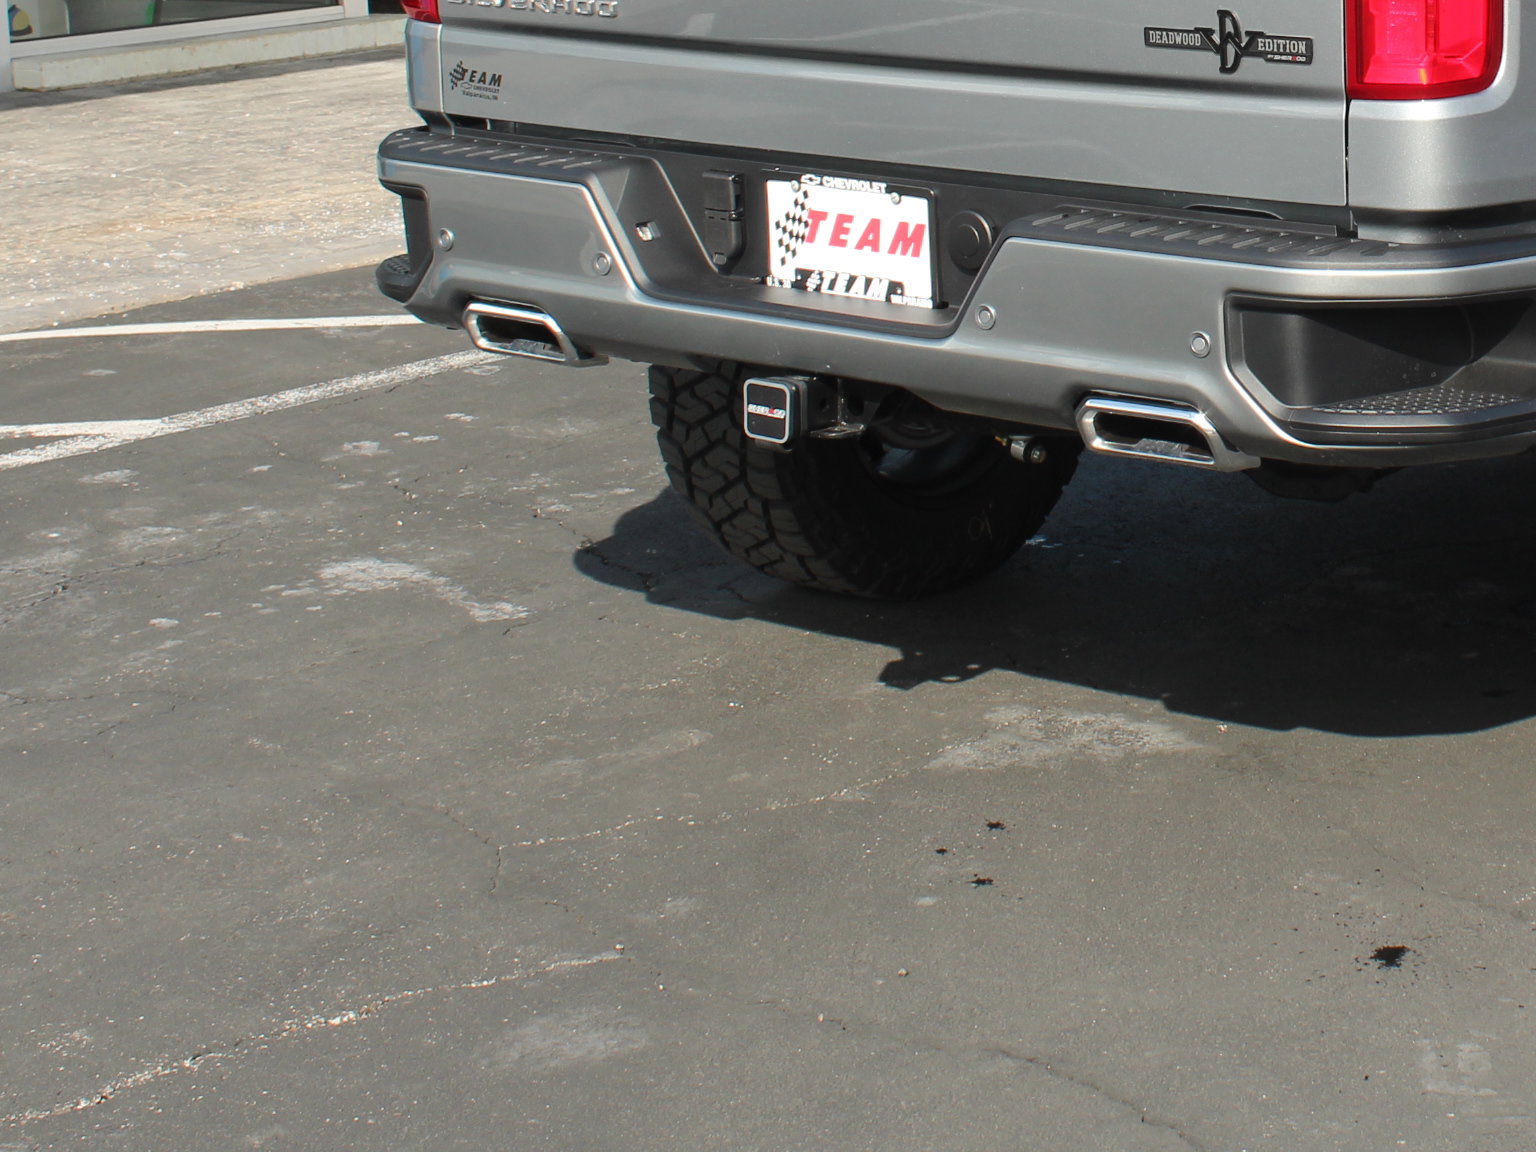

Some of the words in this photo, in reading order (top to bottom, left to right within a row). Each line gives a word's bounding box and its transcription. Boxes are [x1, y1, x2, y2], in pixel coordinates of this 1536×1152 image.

[1149, 30, 1201, 46] DEADWOOD
[1257, 38, 1307, 54] EDITION
[822, 175, 888, 194] CHEVROLET
[805, 209, 927, 258] TEAM
[821, 270, 891, 301] TEAM
